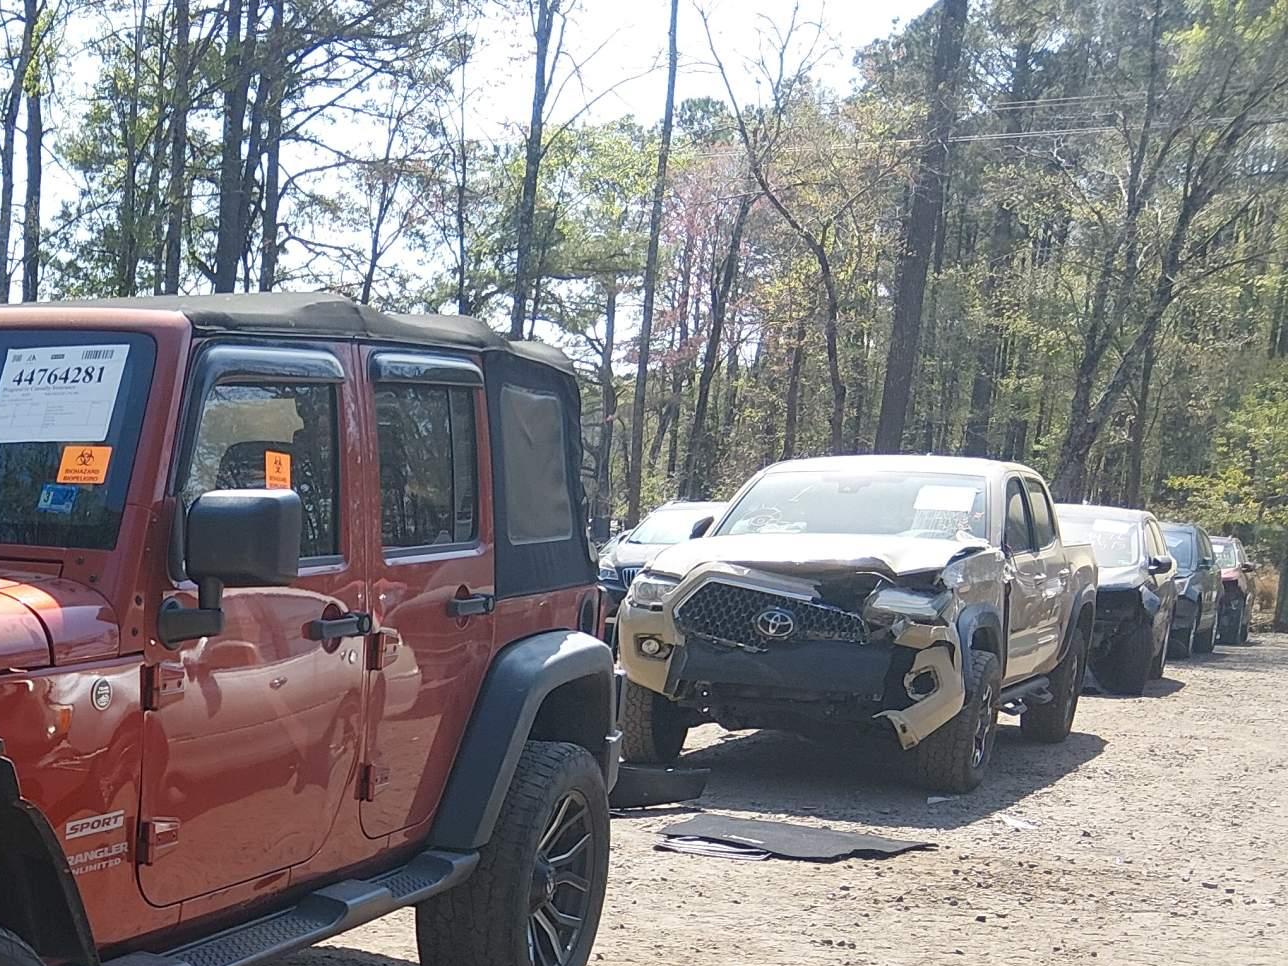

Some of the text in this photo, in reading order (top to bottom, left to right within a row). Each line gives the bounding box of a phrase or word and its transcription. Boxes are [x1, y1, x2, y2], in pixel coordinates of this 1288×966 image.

[12, 366, 105, 386] 44764281
[70, 816, 120, 835] SPORT
[67, 842, 128, 866] RANGLER
